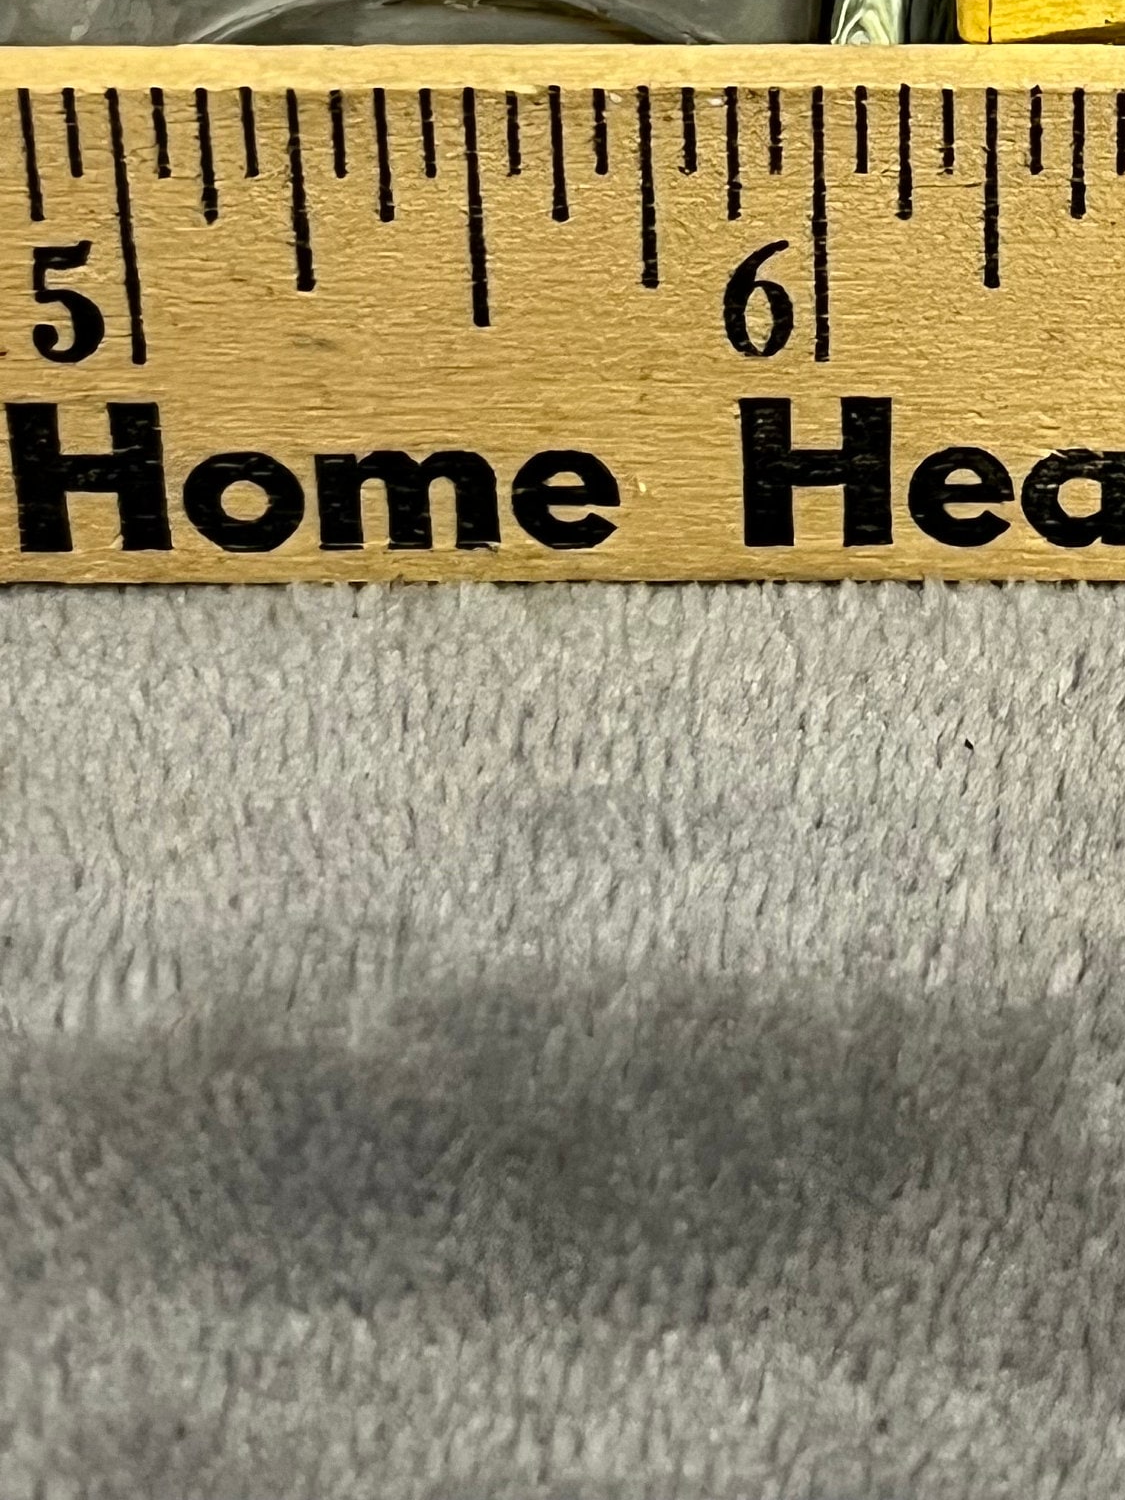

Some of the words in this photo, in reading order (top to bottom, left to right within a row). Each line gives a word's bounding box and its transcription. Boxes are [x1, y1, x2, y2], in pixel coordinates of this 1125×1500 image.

[31, 239, 106, 364] 5
[722, 239, 795, 358] 6
[3, 401, 621, 554] Home
